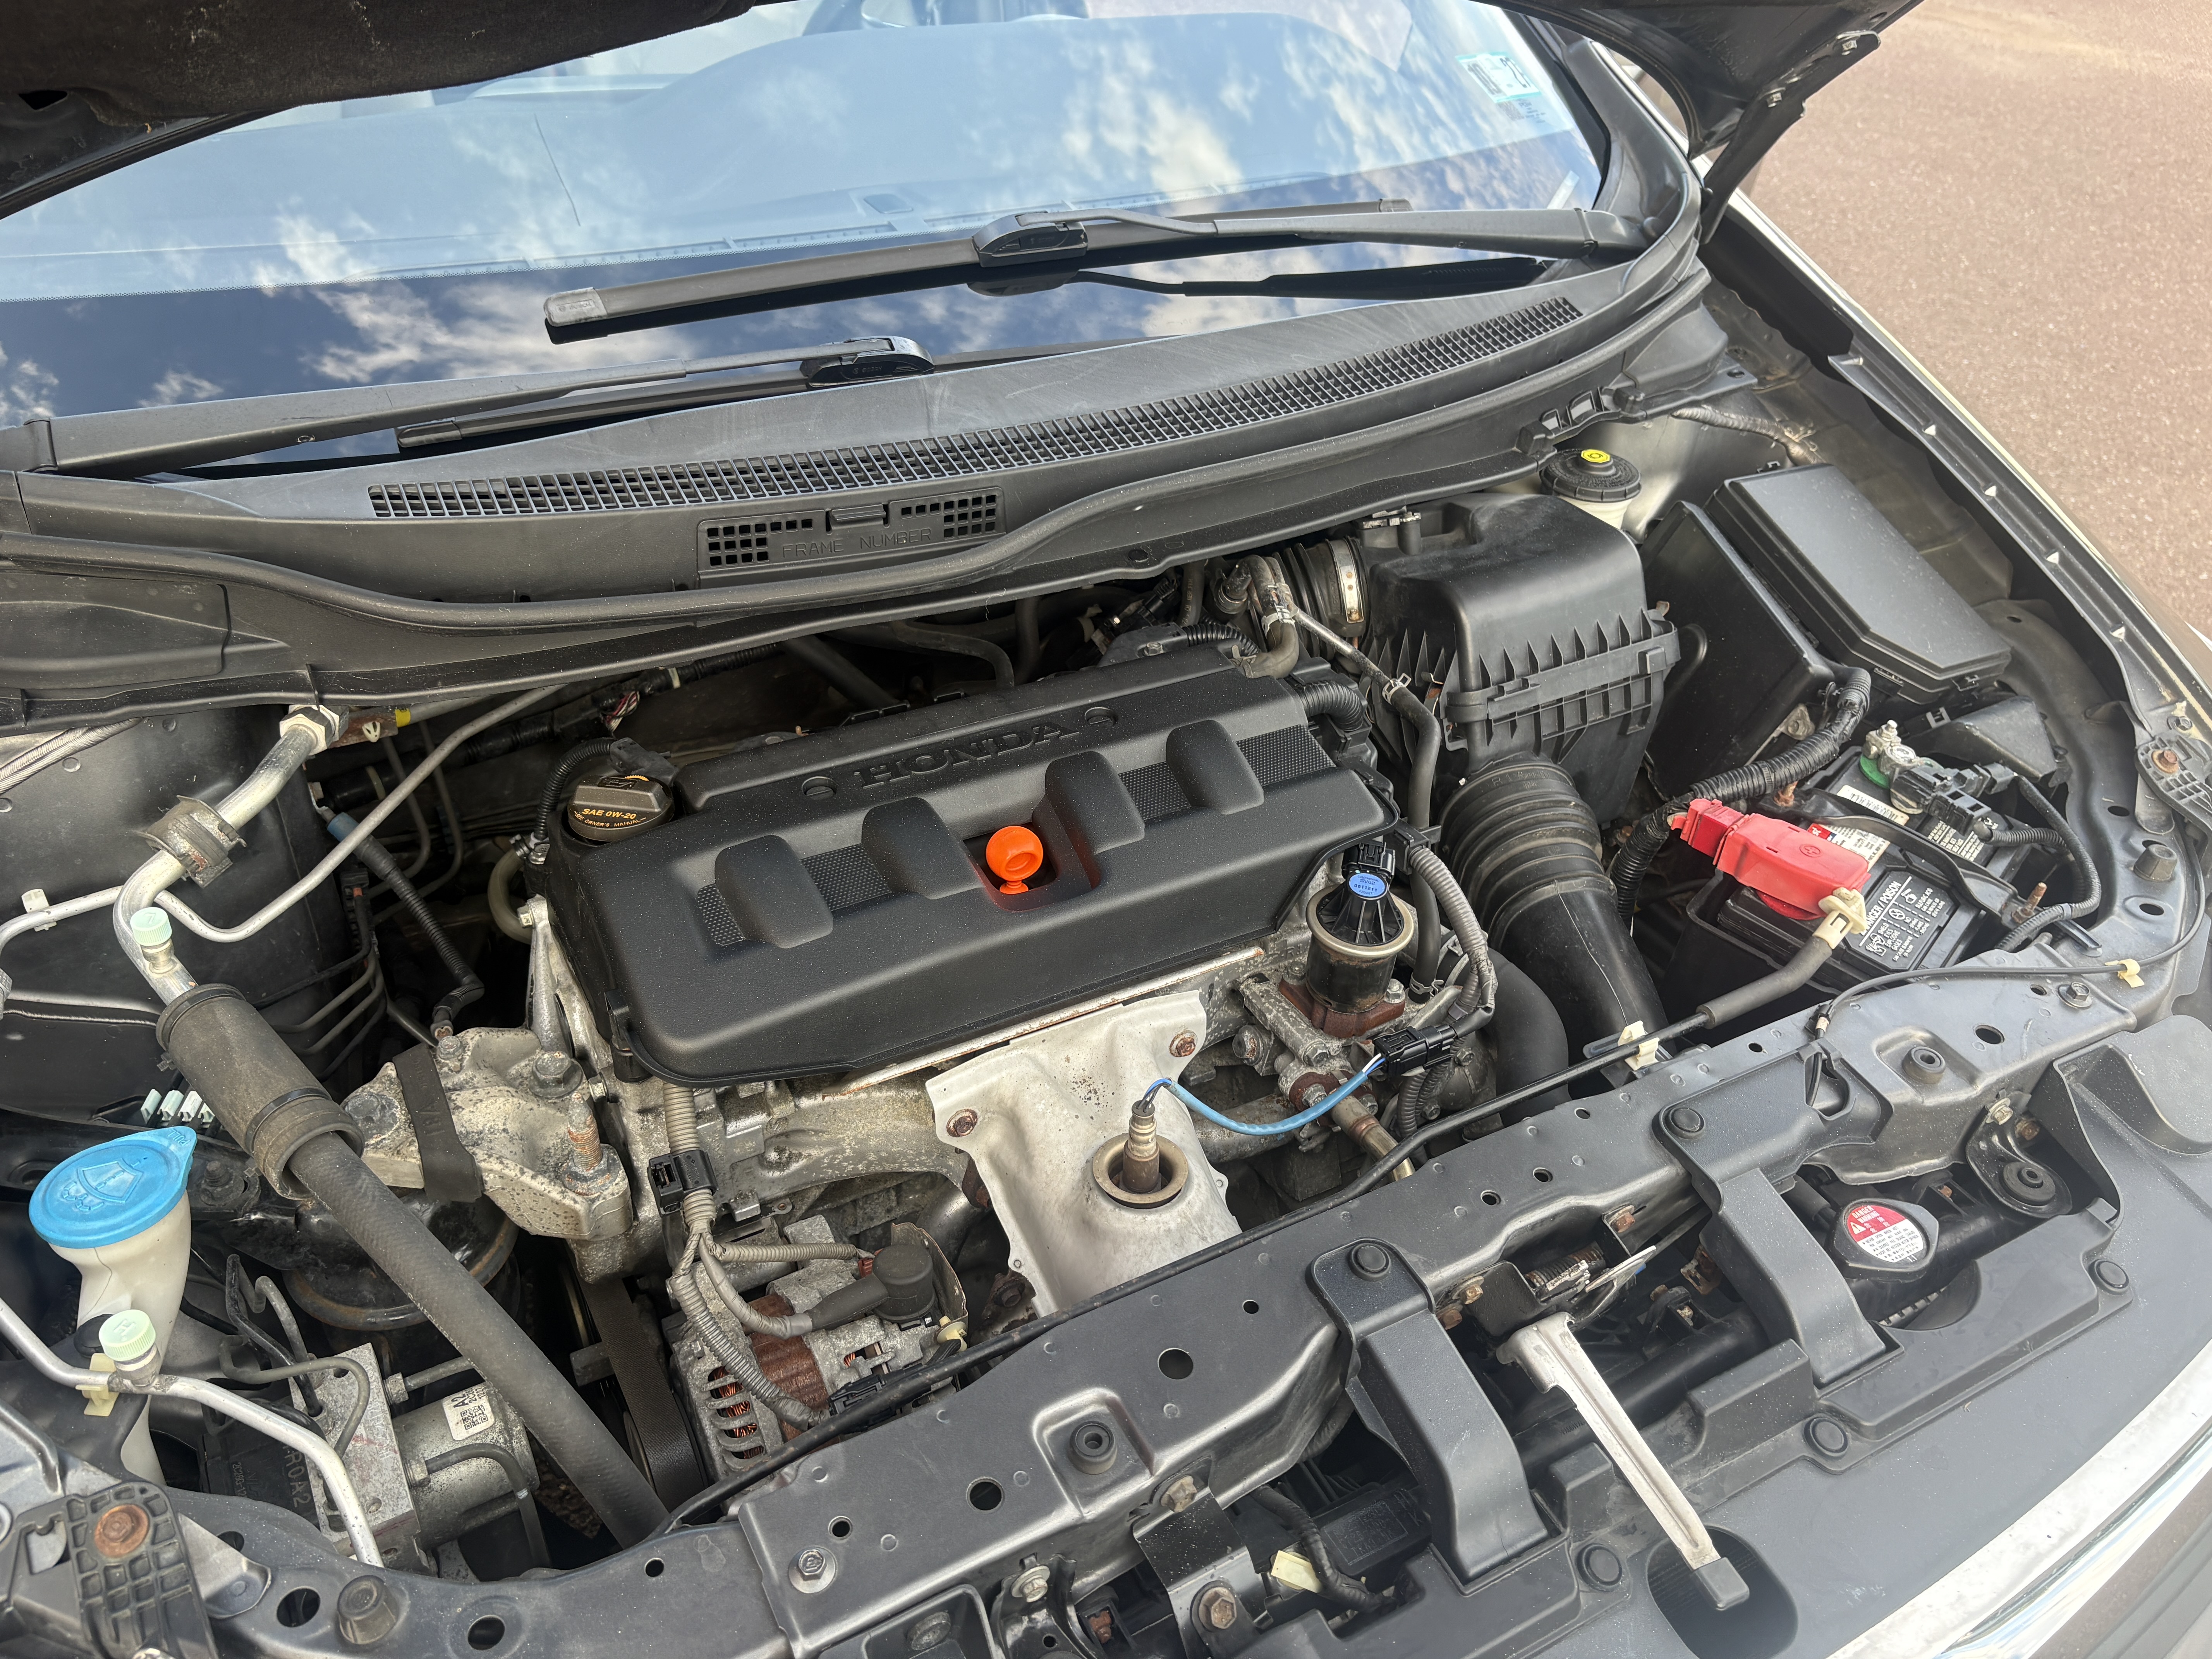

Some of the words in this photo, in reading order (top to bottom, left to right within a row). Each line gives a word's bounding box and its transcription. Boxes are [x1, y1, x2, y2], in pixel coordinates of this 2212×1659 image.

[1468, 64, 1502, 95] 10
[783, 539, 844, 558] FRAME
[859, 527, 932, 550] NUMBER
[853, 721, 1080, 789] HONDA
[584, 819, 610, 827] OWNER'S
[605, 811, 636, 819] 0W-20
[1880, 881, 1901, 904] POISON
[167, 1128, 191, 1147] PULL
[1851, 1205, 1874, 1219] DANGER
[1857, 1211, 1880, 1224] WARNING
[453, 1393, 468, 1408] A2
